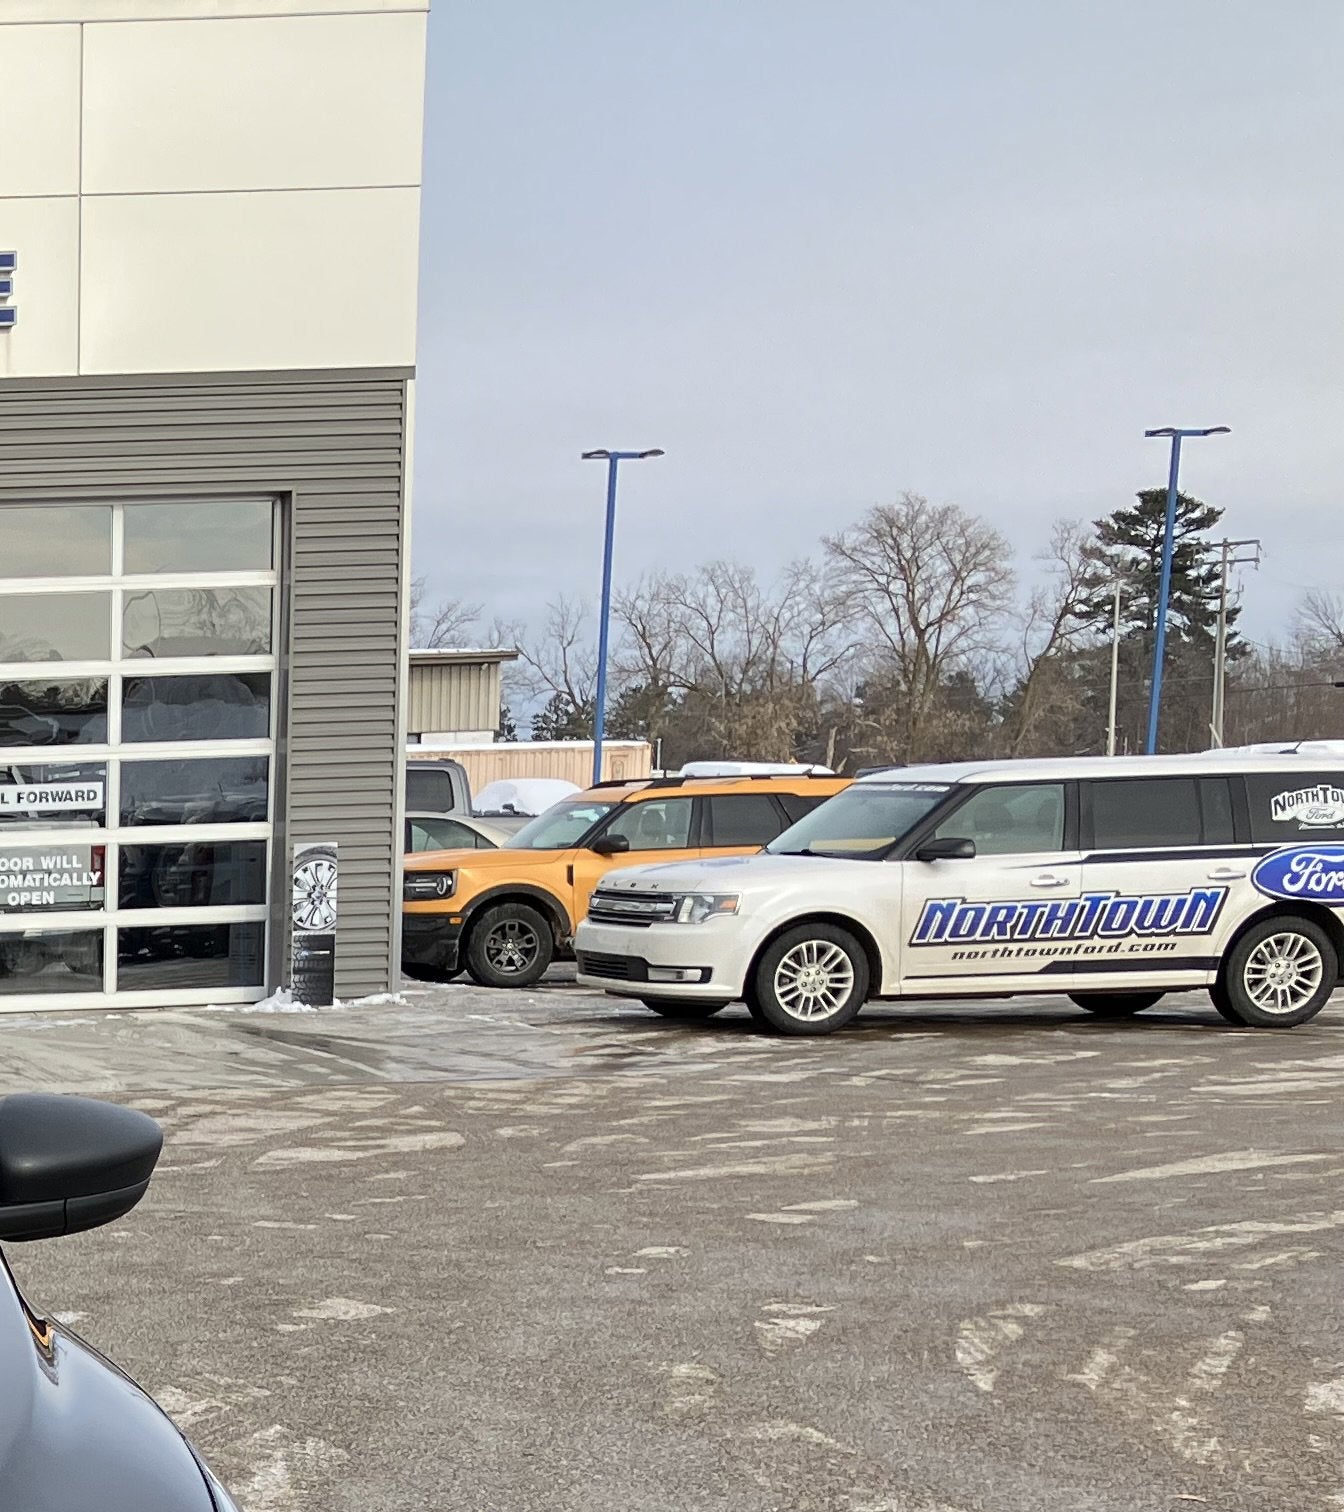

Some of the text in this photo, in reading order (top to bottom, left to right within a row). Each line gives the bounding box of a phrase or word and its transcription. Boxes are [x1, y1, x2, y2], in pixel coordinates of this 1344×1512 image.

[16, 789, 98, 804] FORWARD
[1272, 786, 1344, 817] NORTHTO
[40, 855, 83, 869] WILL
[7, 891, 55, 905] OPEN
[951, 941, 1178, 961] northtownford.com
